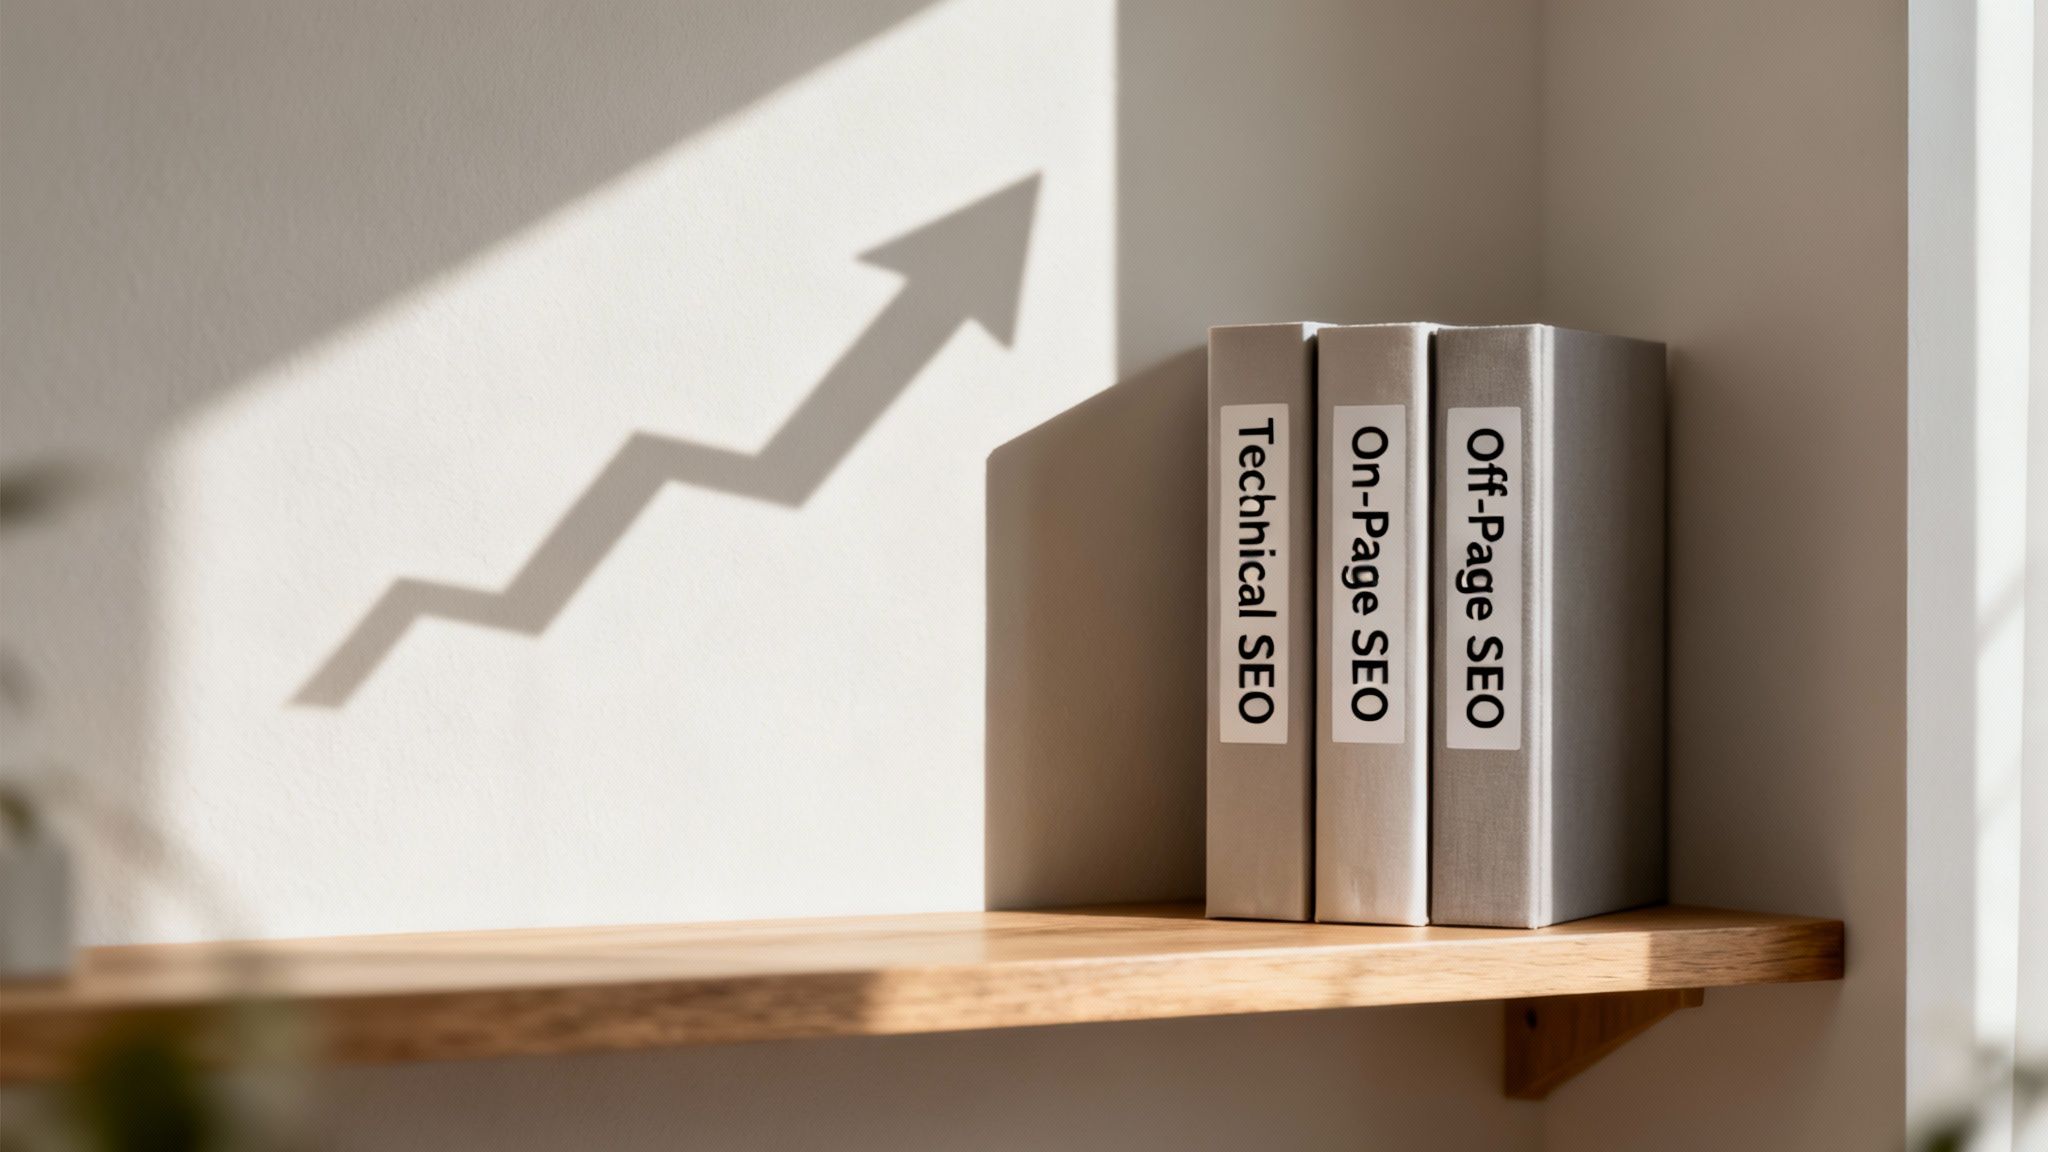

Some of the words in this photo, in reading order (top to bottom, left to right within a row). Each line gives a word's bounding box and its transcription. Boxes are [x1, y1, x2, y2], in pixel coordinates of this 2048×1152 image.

[1341, 425, 1390, 616] On-Page
[1454, 427, 1509, 622] Off-Page
[1237, 634, 1275, 725] SEO
[1350, 629, 1389, 722] SEO
[1466, 635, 1505, 729] SEO
